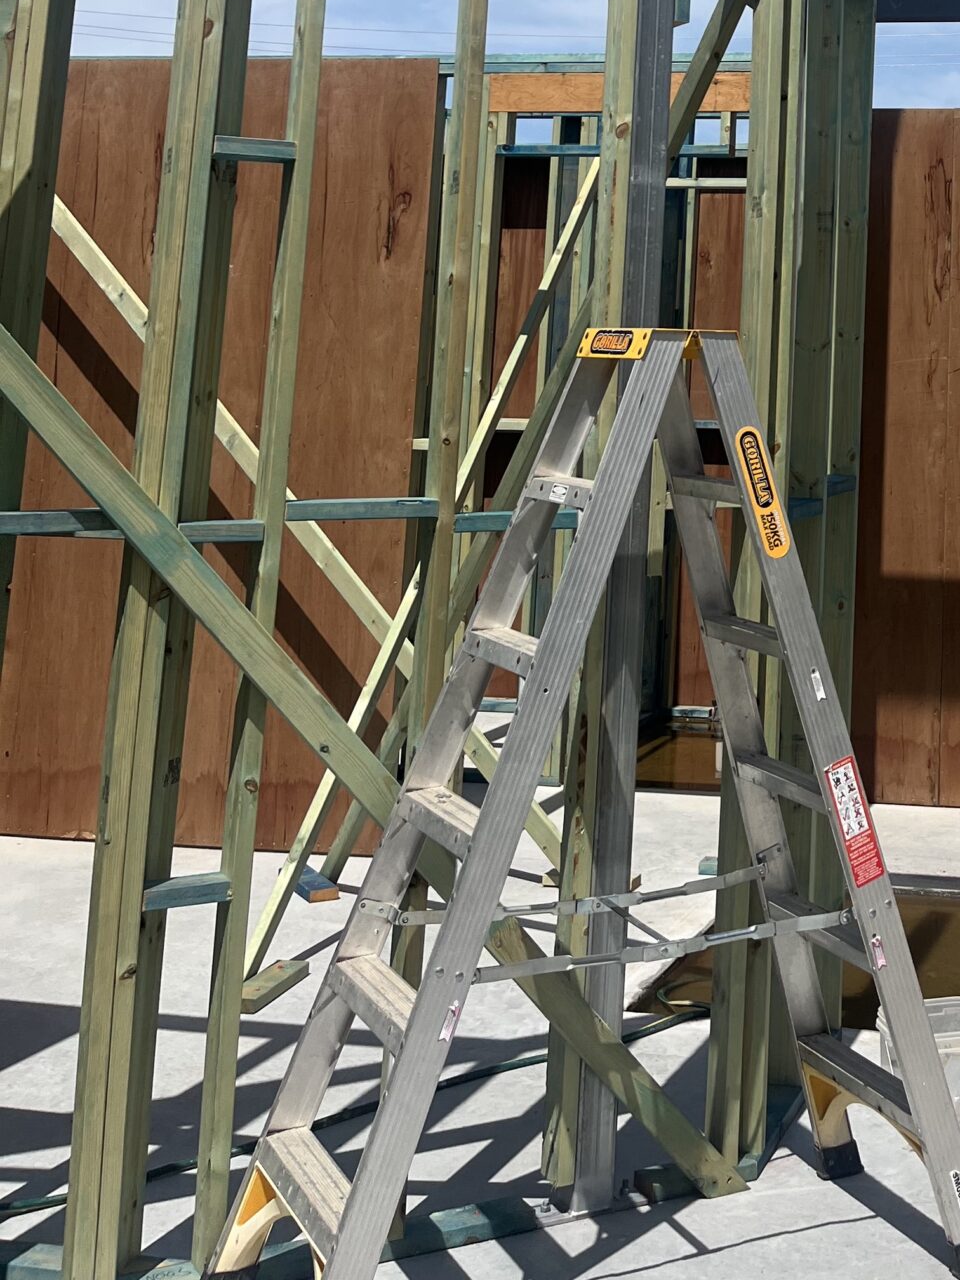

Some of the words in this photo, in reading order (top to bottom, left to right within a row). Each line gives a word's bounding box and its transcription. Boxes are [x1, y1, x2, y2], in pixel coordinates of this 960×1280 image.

[592, 332, 632, 352] GORILLA
[744, 435, 772, 505] GORILLA
[760, 514, 769, 531] MAX
[765, 532, 774, 551] LOAD
[765, 512, 783, 548] 150KG
